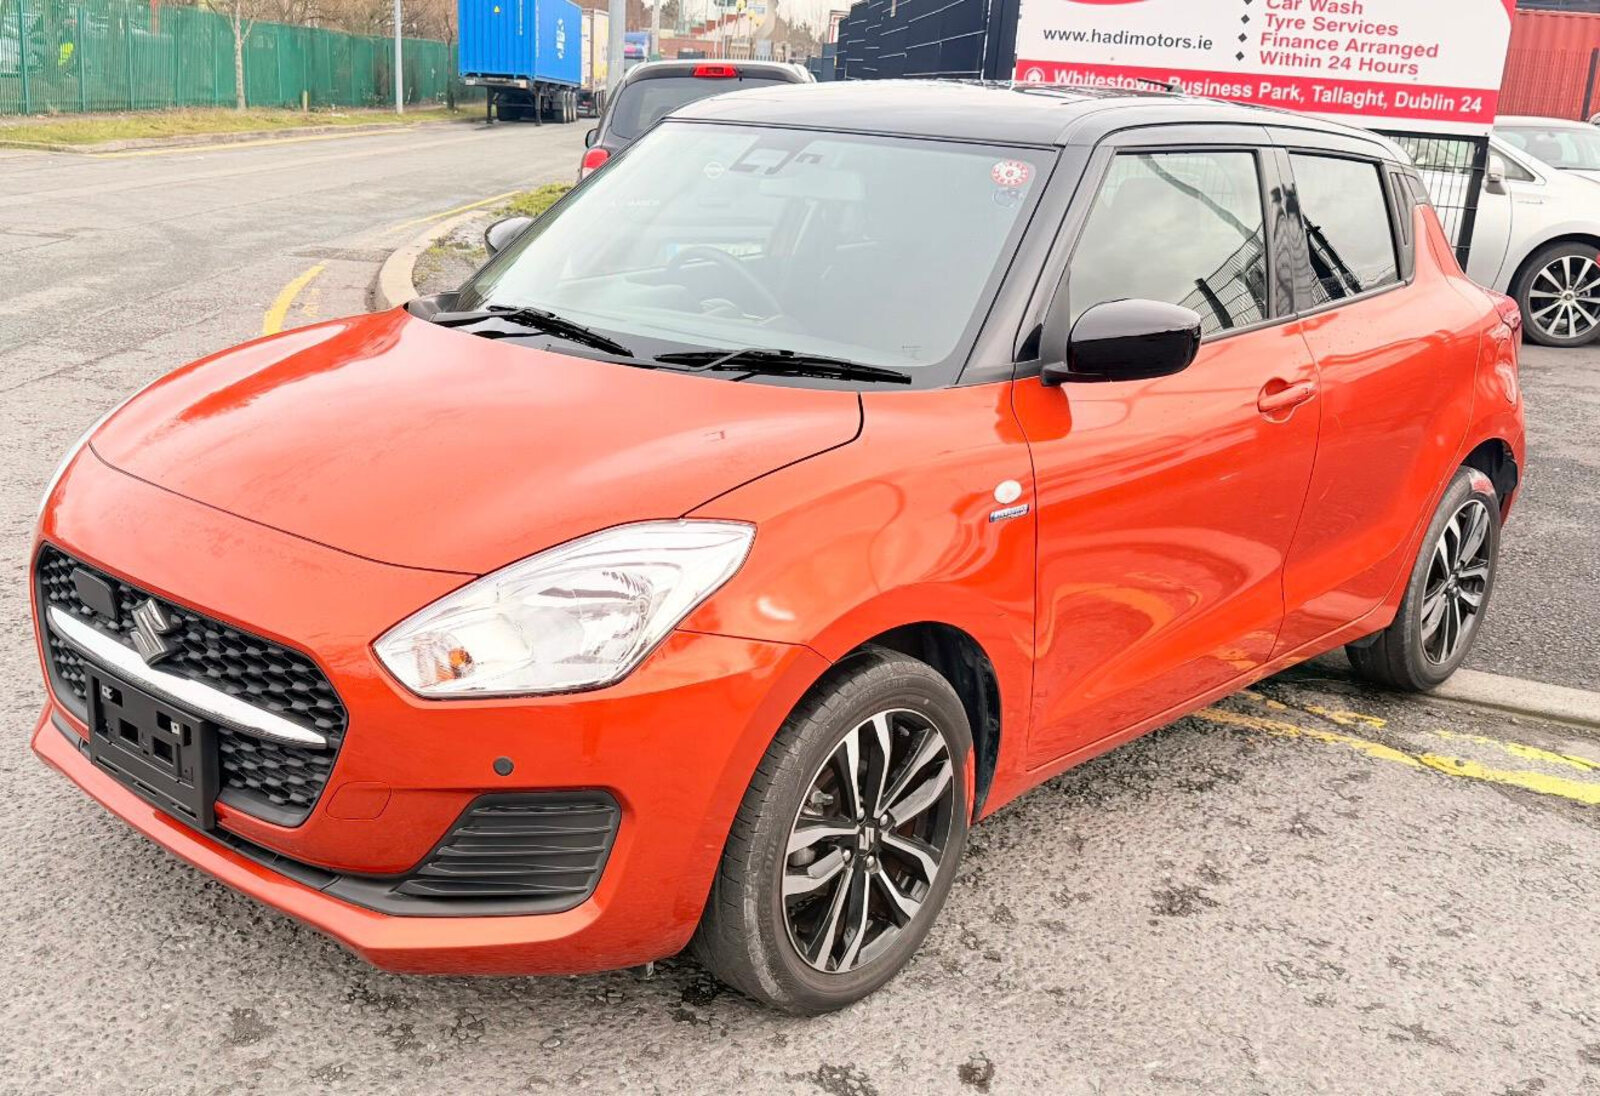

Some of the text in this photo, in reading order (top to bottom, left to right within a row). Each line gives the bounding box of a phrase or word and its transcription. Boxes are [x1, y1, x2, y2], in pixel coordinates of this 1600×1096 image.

[1266, 0, 1363, 15] Car Wash
[1265, 13, 1399, 36] Tyre Services
[1043, 28, 1213, 50] www.hadimotors.ie
[1260, 32, 1439, 59] Finance Arranged
[1259, 50, 1419, 75] Within 24 Hours
[1258, 82, 1305, 103] Park,
[1311, 85, 1388, 109] Tallaght,
[1394, 91, 1454, 111] Dublin
[1459, 96, 1482, 113] 24
